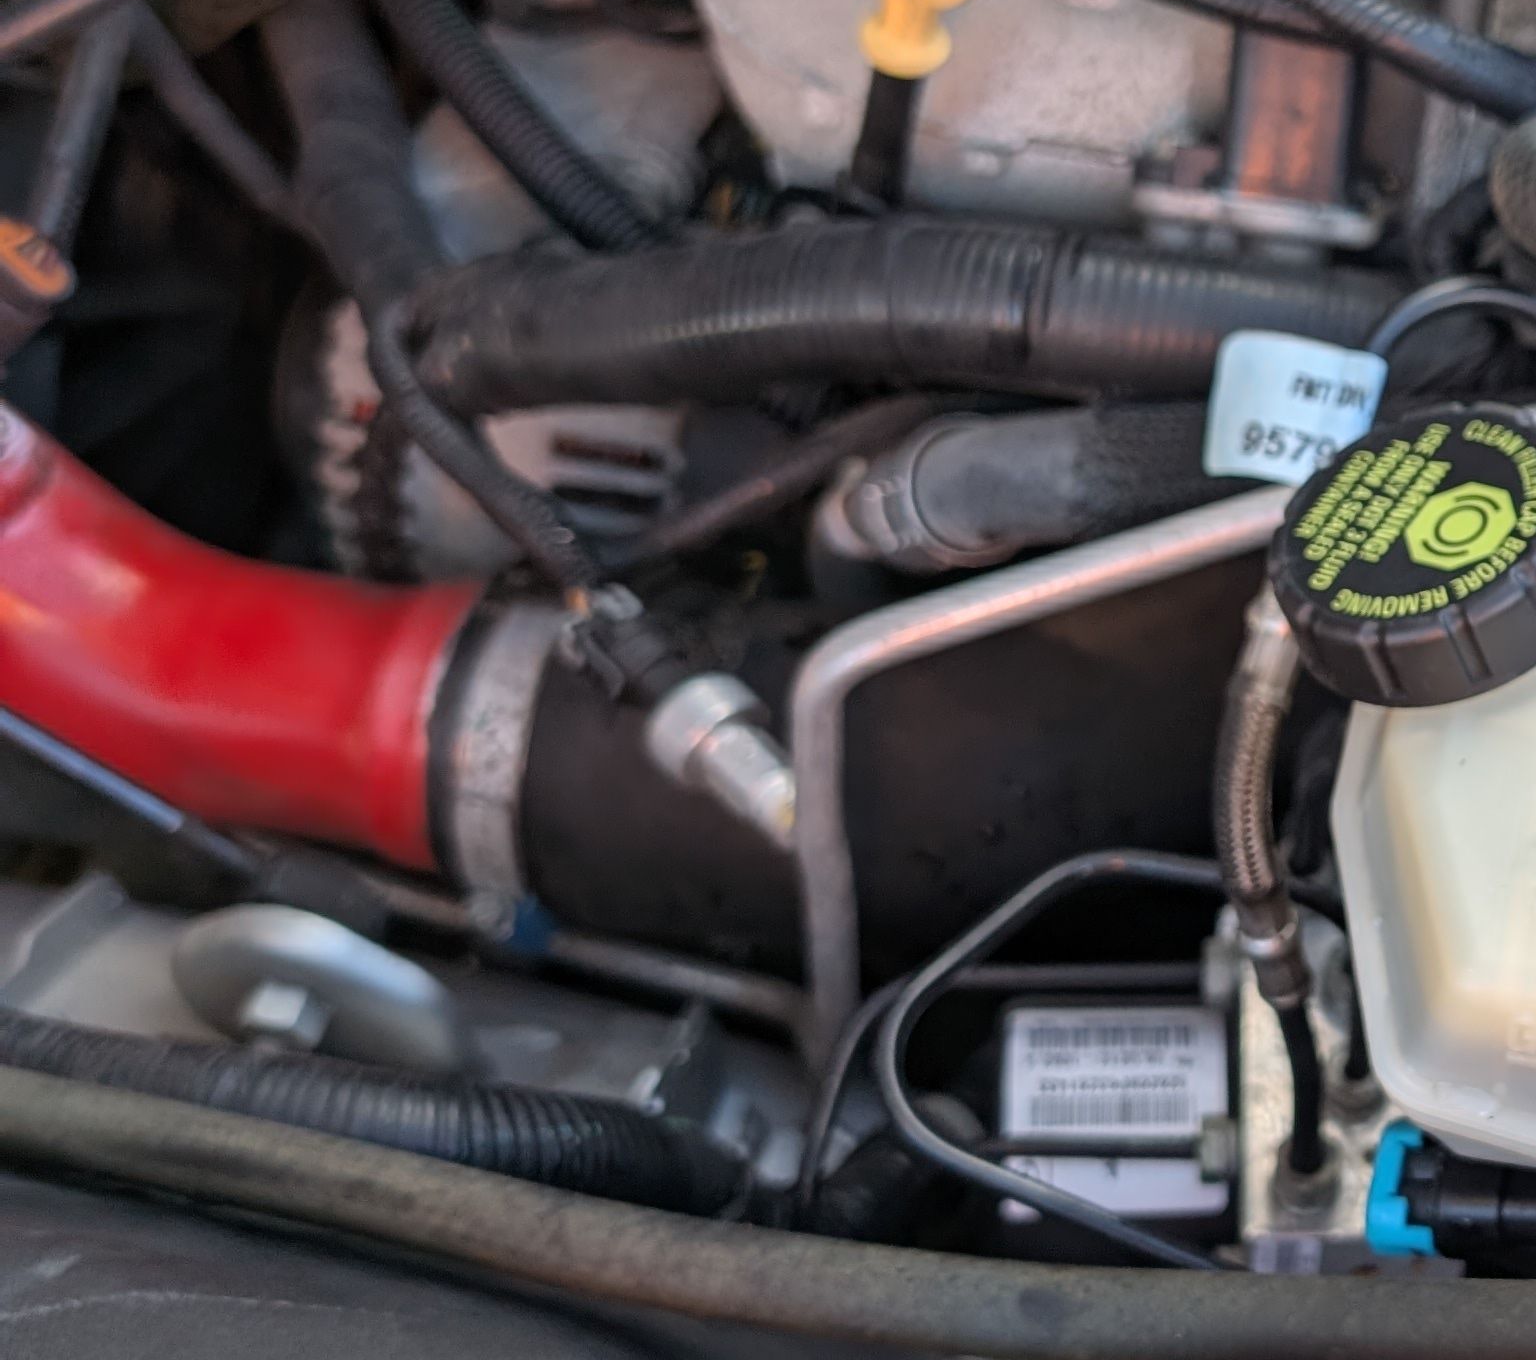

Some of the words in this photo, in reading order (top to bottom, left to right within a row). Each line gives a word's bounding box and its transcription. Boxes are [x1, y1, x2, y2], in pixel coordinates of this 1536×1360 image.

[1462, 419, 1527, 456] CLEAN
[1450, 536, 1527, 600] BEFORE
[1329, 584, 1449, 619] REMOVING
